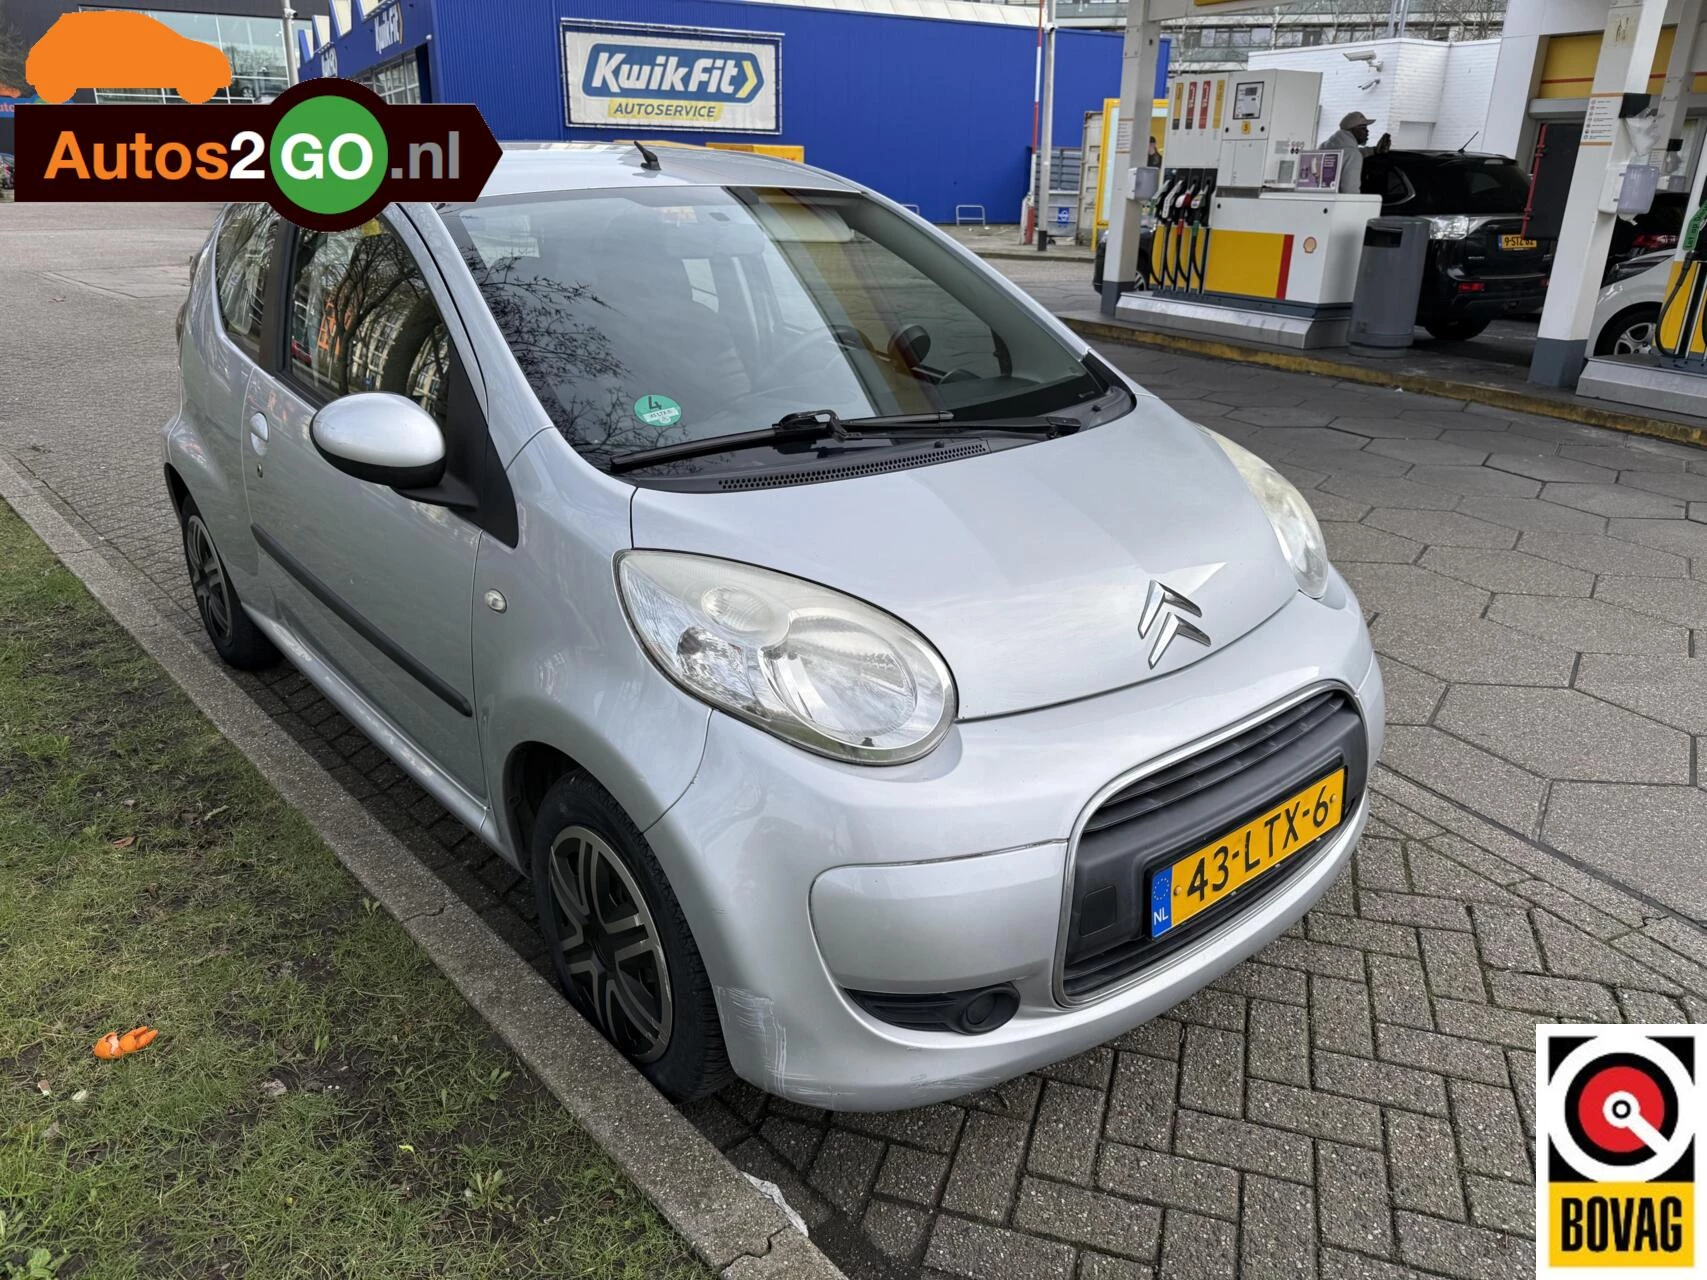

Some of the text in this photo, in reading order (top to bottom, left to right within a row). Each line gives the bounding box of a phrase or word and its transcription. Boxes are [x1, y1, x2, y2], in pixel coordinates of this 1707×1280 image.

[614, 103, 716, 118] AUTOSERVICE
[647, 396, 662, 410] 4
[1187, 785, 1329, 902] 43-LTX-6
[1154, 907, 1169, 926] NL
